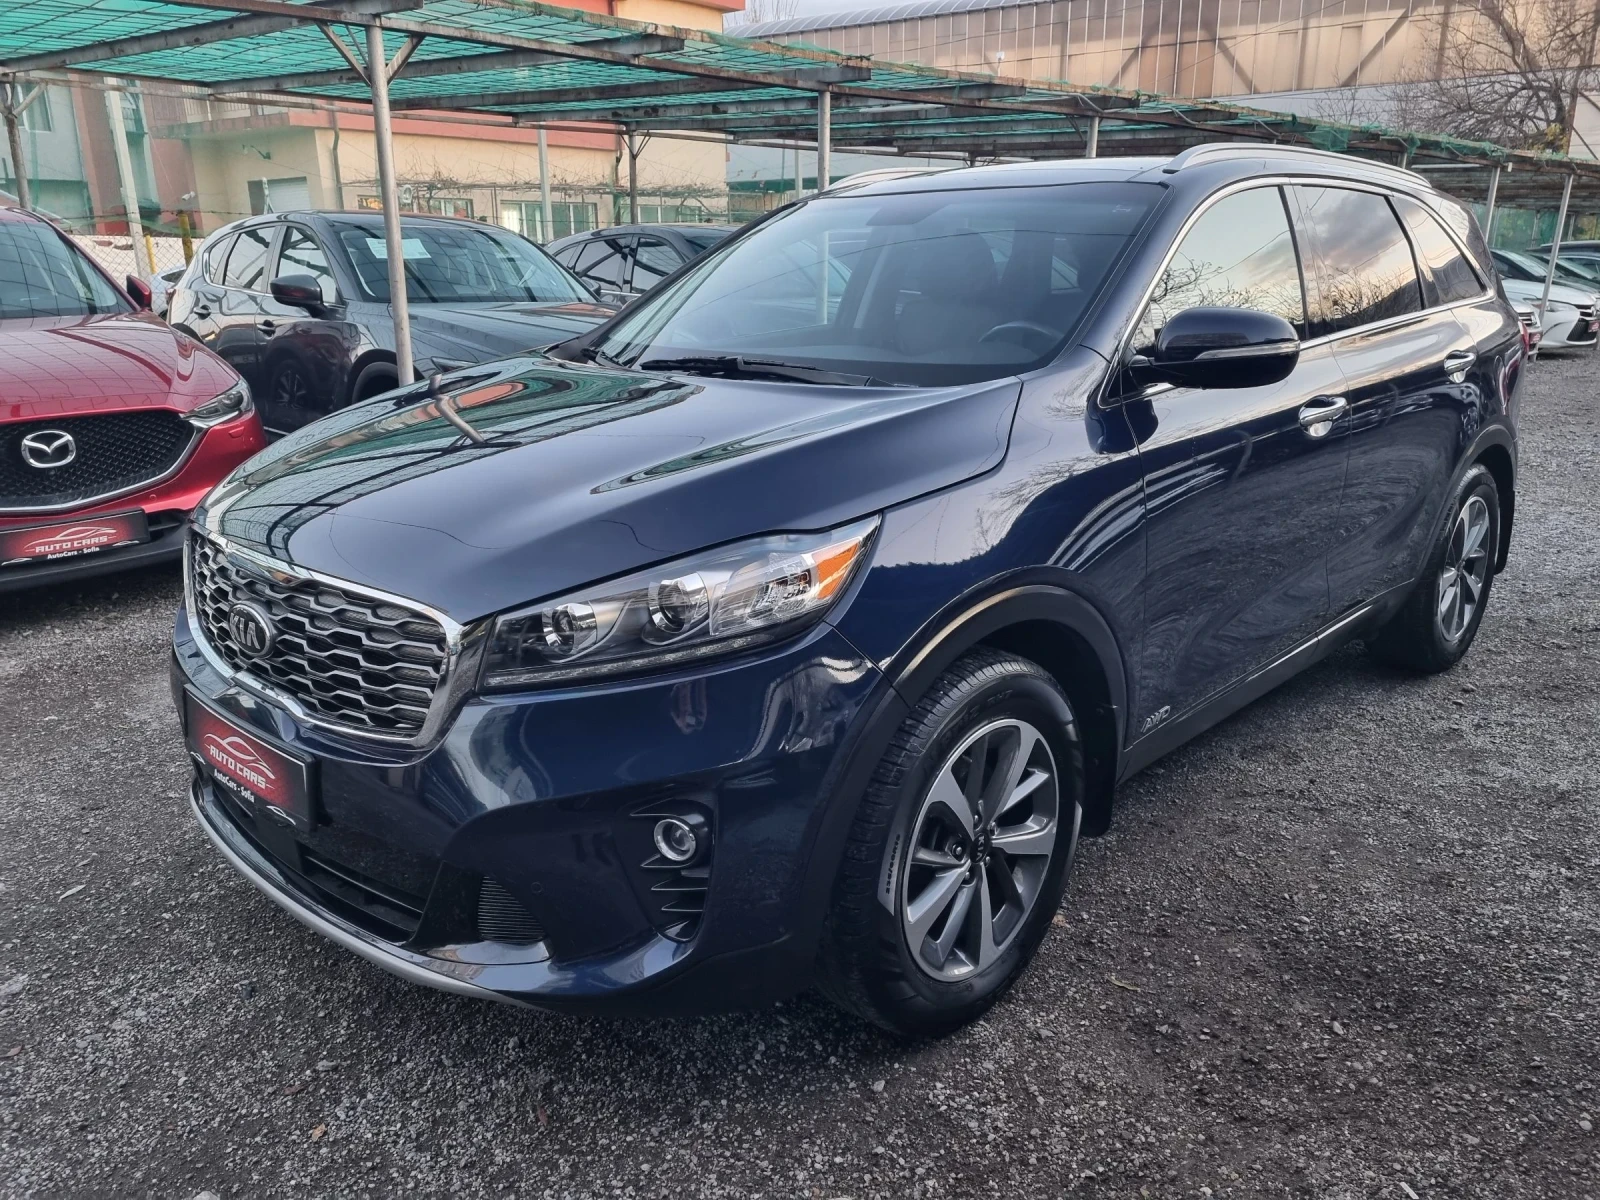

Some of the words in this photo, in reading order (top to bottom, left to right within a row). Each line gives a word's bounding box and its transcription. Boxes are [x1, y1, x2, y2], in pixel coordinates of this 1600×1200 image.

[35, 541, 71, 553] AUTO
[74, 535, 108, 547] CARS
[47, 549, 78, 559] AutoCars
[83, 546, 100, 554] Sofia
[230, 612, 260, 650] KIA
[1141, 705, 1170, 733] AWD
[209, 744, 235, 769] AUTO
[236, 763, 266, 790] CARS
[214, 768, 237, 791] AutoCars
[241, 786, 255, 803] Sofia
[976, 836, 985, 861] KIA
